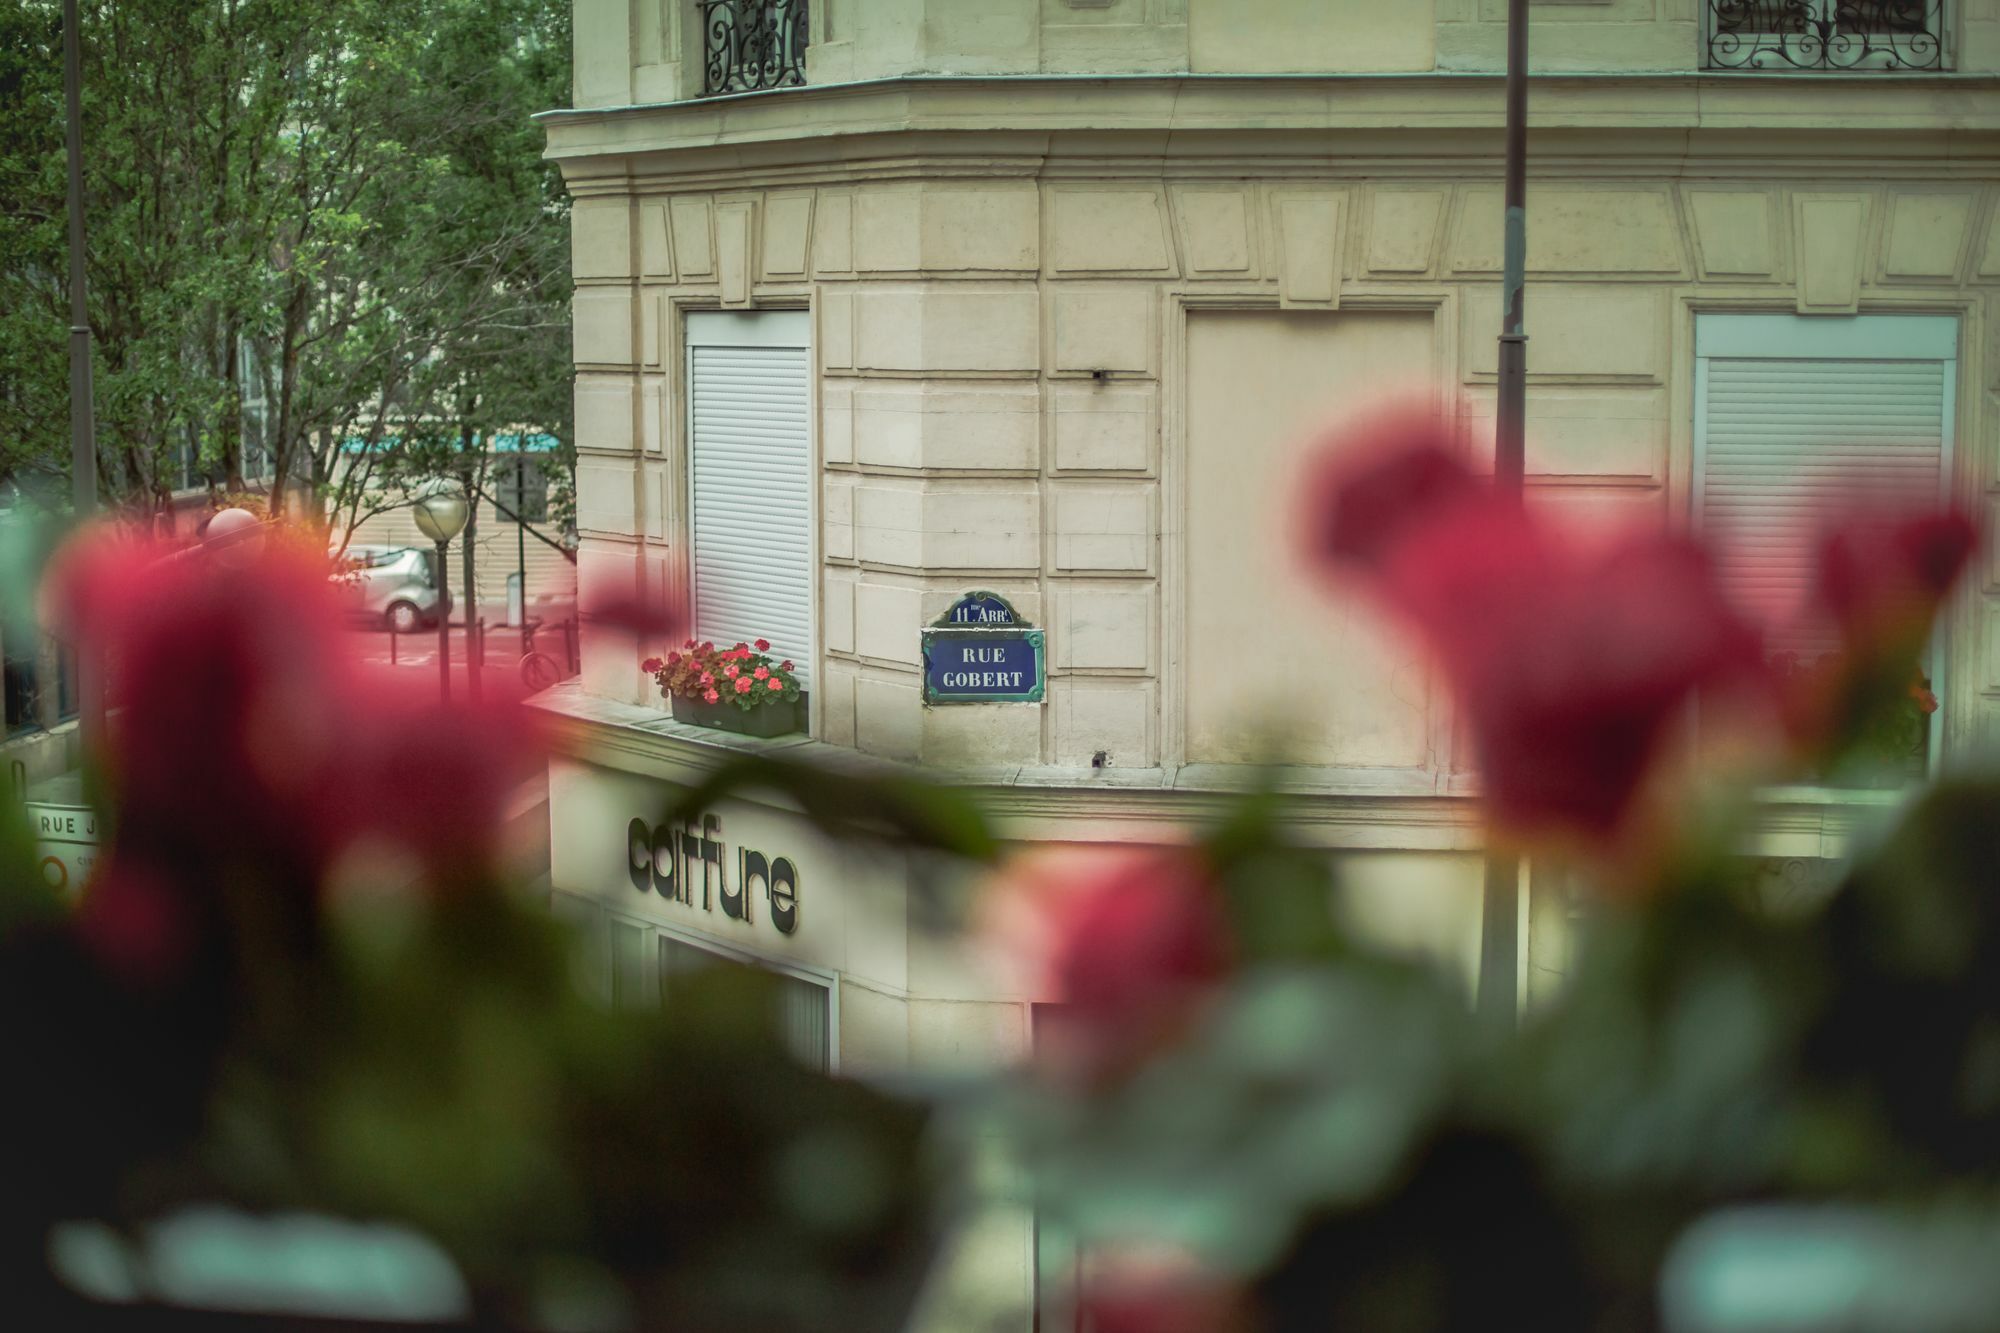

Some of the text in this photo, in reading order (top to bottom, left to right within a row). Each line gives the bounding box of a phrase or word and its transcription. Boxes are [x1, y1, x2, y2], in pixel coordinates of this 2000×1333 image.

[962, 648, 1006, 663] RUE
[942, 671, 1023, 687] GOBERT
[41, 816, 75, 833] RUE
[628, 812, 798, 933] coiffure
